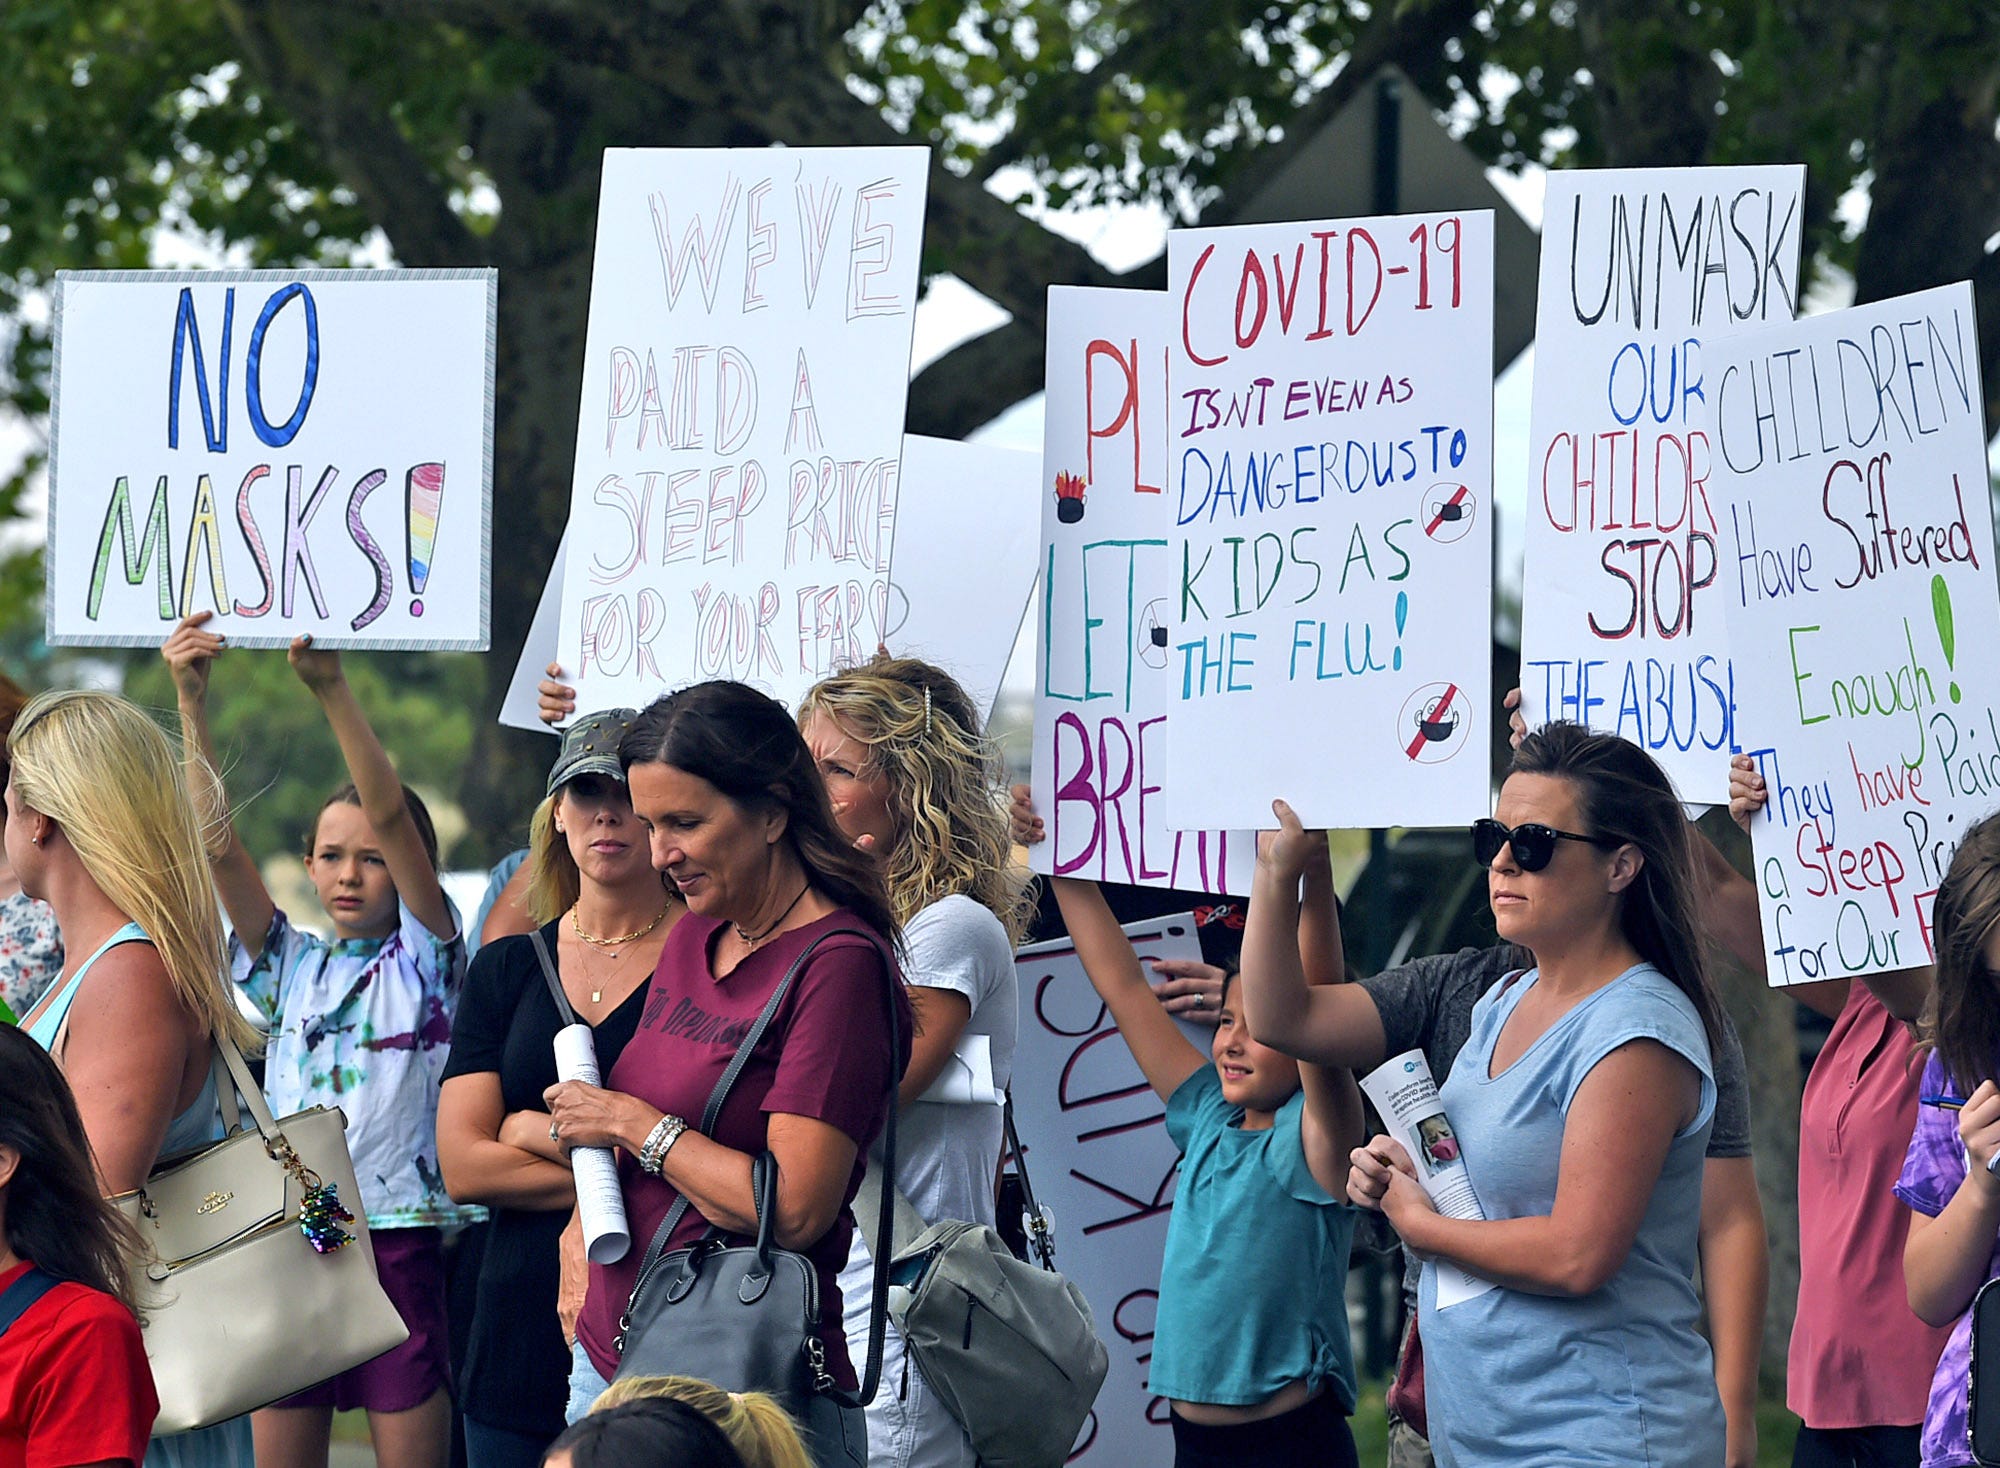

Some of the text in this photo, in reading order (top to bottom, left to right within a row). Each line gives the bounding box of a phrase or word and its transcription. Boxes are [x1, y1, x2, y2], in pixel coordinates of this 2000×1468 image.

[648, 158, 905, 323] WE'VE
[1182, 216, 1462, 367] COVID-19
[1570, 188, 1798, 331] UNMASK
[168, 281, 320, 453] NO
[606, 345, 825, 457] PAID A
[1085, 338, 1169, 494] PL
[1283, 375, 1370, 421] EVEN
[1375, 375, 1415, 405] AS
[1608, 338, 1705, 425] OUR
[1719, 309, 1970, 474] CHILDREN
[589, 456, 898, 585] STEEP PRICE
[1176, 426, 1467, 526] DANGEROUS TO
[1543, 429, 1718, 535] CHILDR
[86, 460, 446, 632] MASKS!
[1181, 518, 1412, 623] KIDS AS
[1587, 530, 1718, 640] STOP
[1731, 500, 1819, 607] Have
[579, 587, 666, 682] FOR
[691, 581, 784, 682] YOUR
[1176, 591, 1408, 700] THE FLU!
[1789, 574, 1962, 770] Enough!
[1526, 657, 1609, 726] THE
[1747, 748, 1837, 848] They
[1847, 741, 1932, 813] have
[1763, 810, 1957, 919] a Steep Pri
[1774, 904, 1827, 986] for
[1836, 899, 1902, 971] Our
